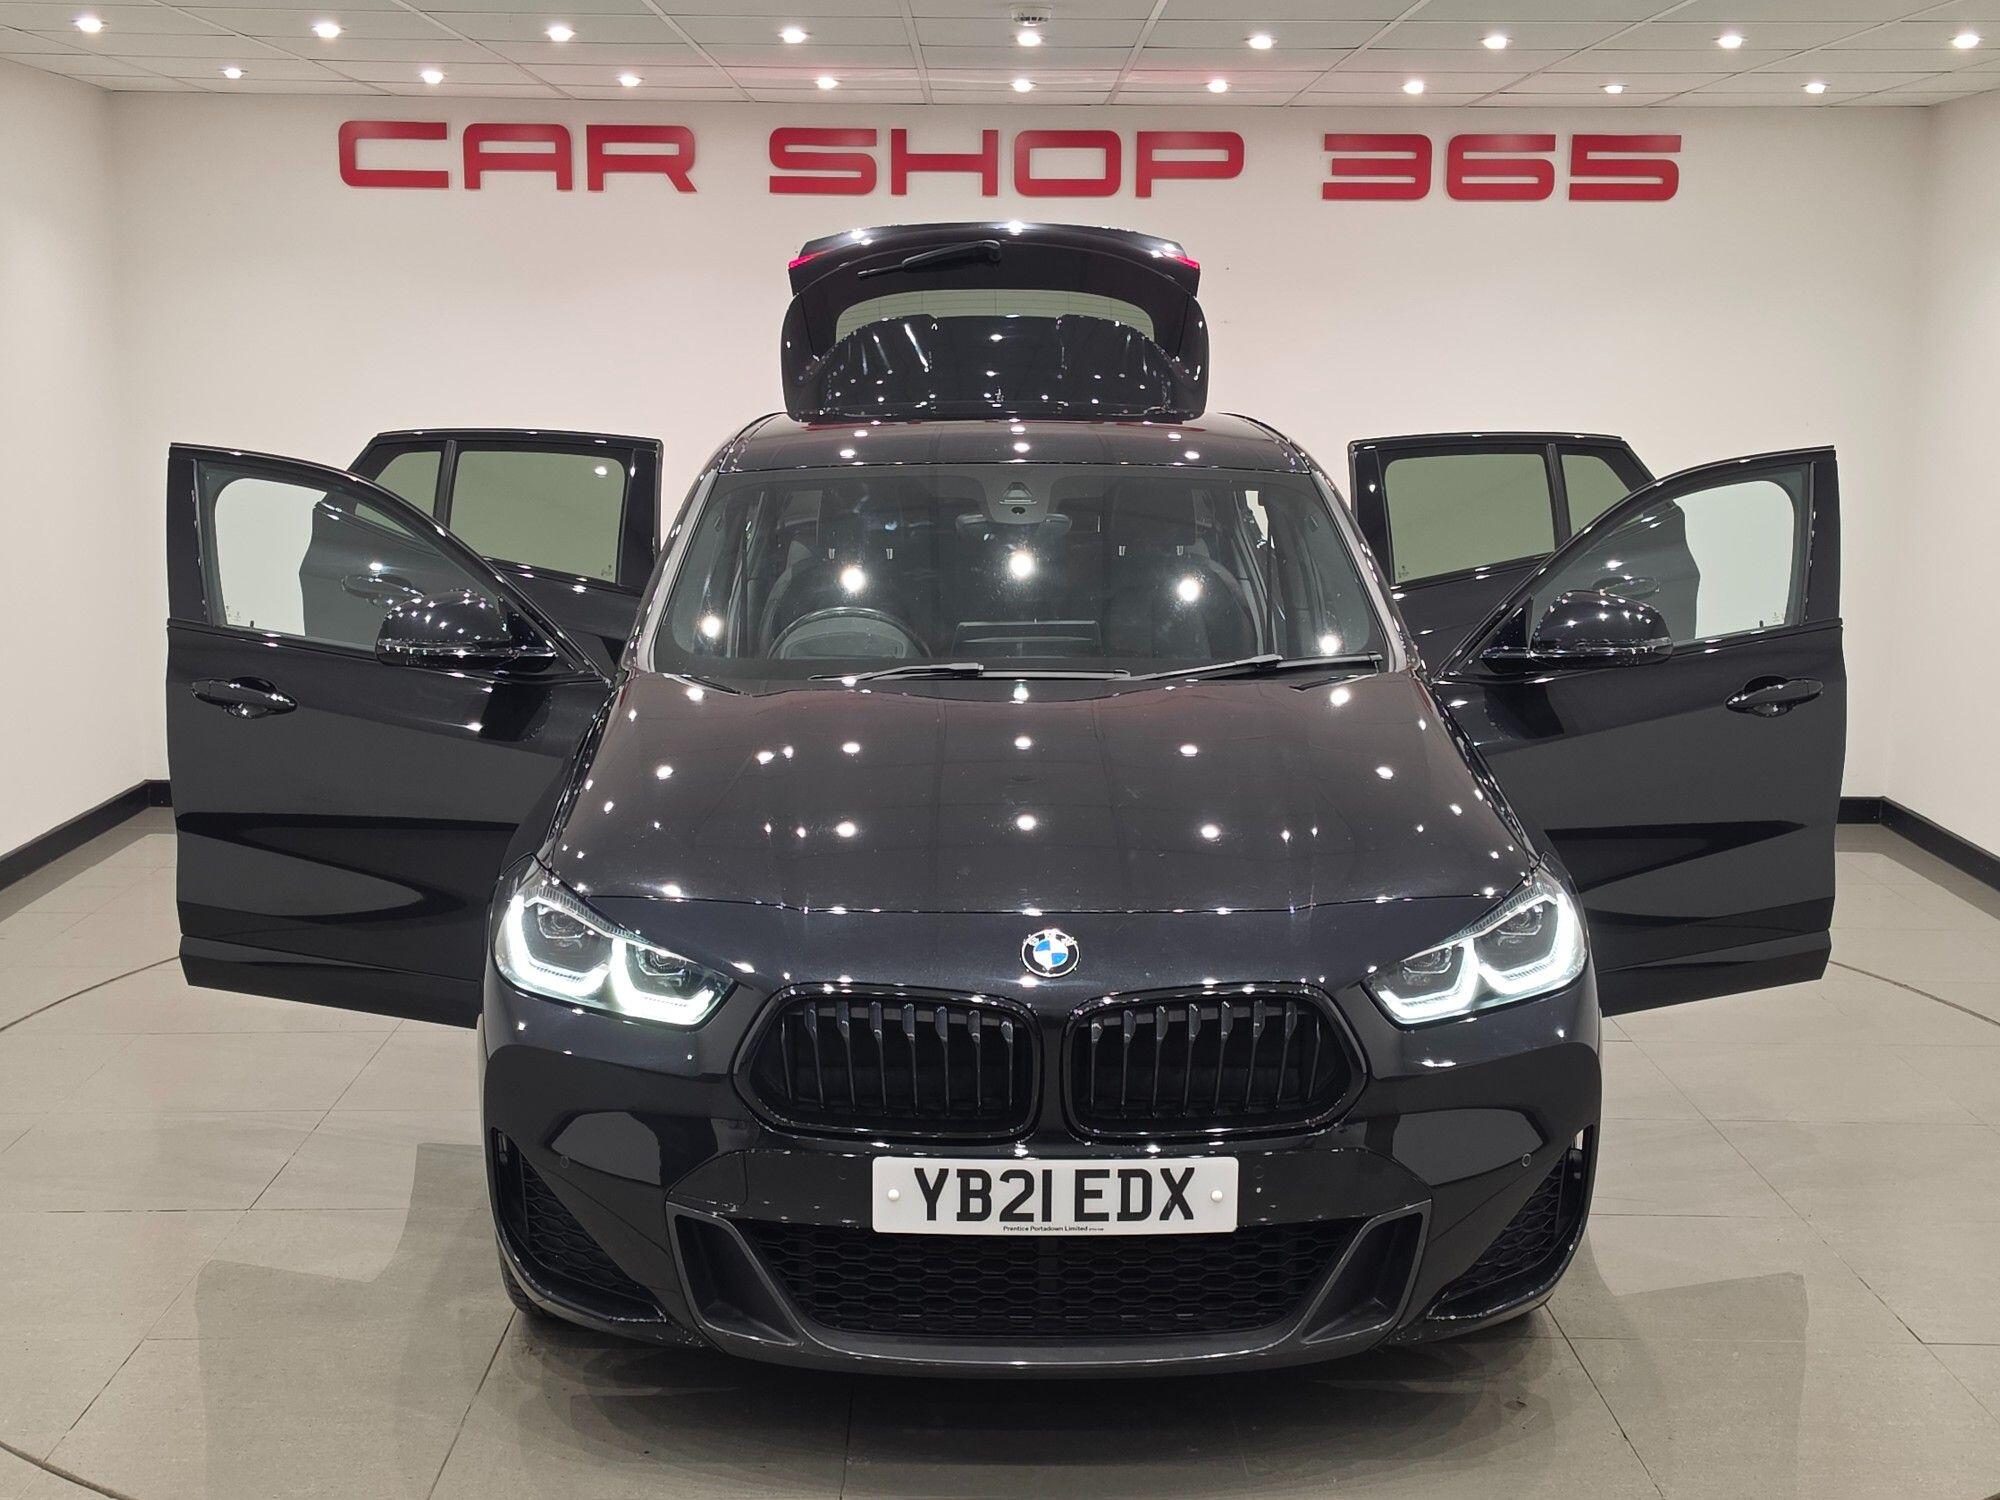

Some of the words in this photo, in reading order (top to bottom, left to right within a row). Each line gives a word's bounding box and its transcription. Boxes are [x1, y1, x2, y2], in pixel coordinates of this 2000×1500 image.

[338, 120, 697, 193] CAR
[768, 127, 1245, 199] SHOP
[1321, 134, 1682, 201] 365
[913, 1167, 1053, 1223] YB21
[1074, 1166, 1196, 1222] EDX
[1002, 1224, 1029, 1232] Prentice
[1030, 1224, 1063, 1232] Portadown
[1064, 1224, 1088, 1232] Limited
